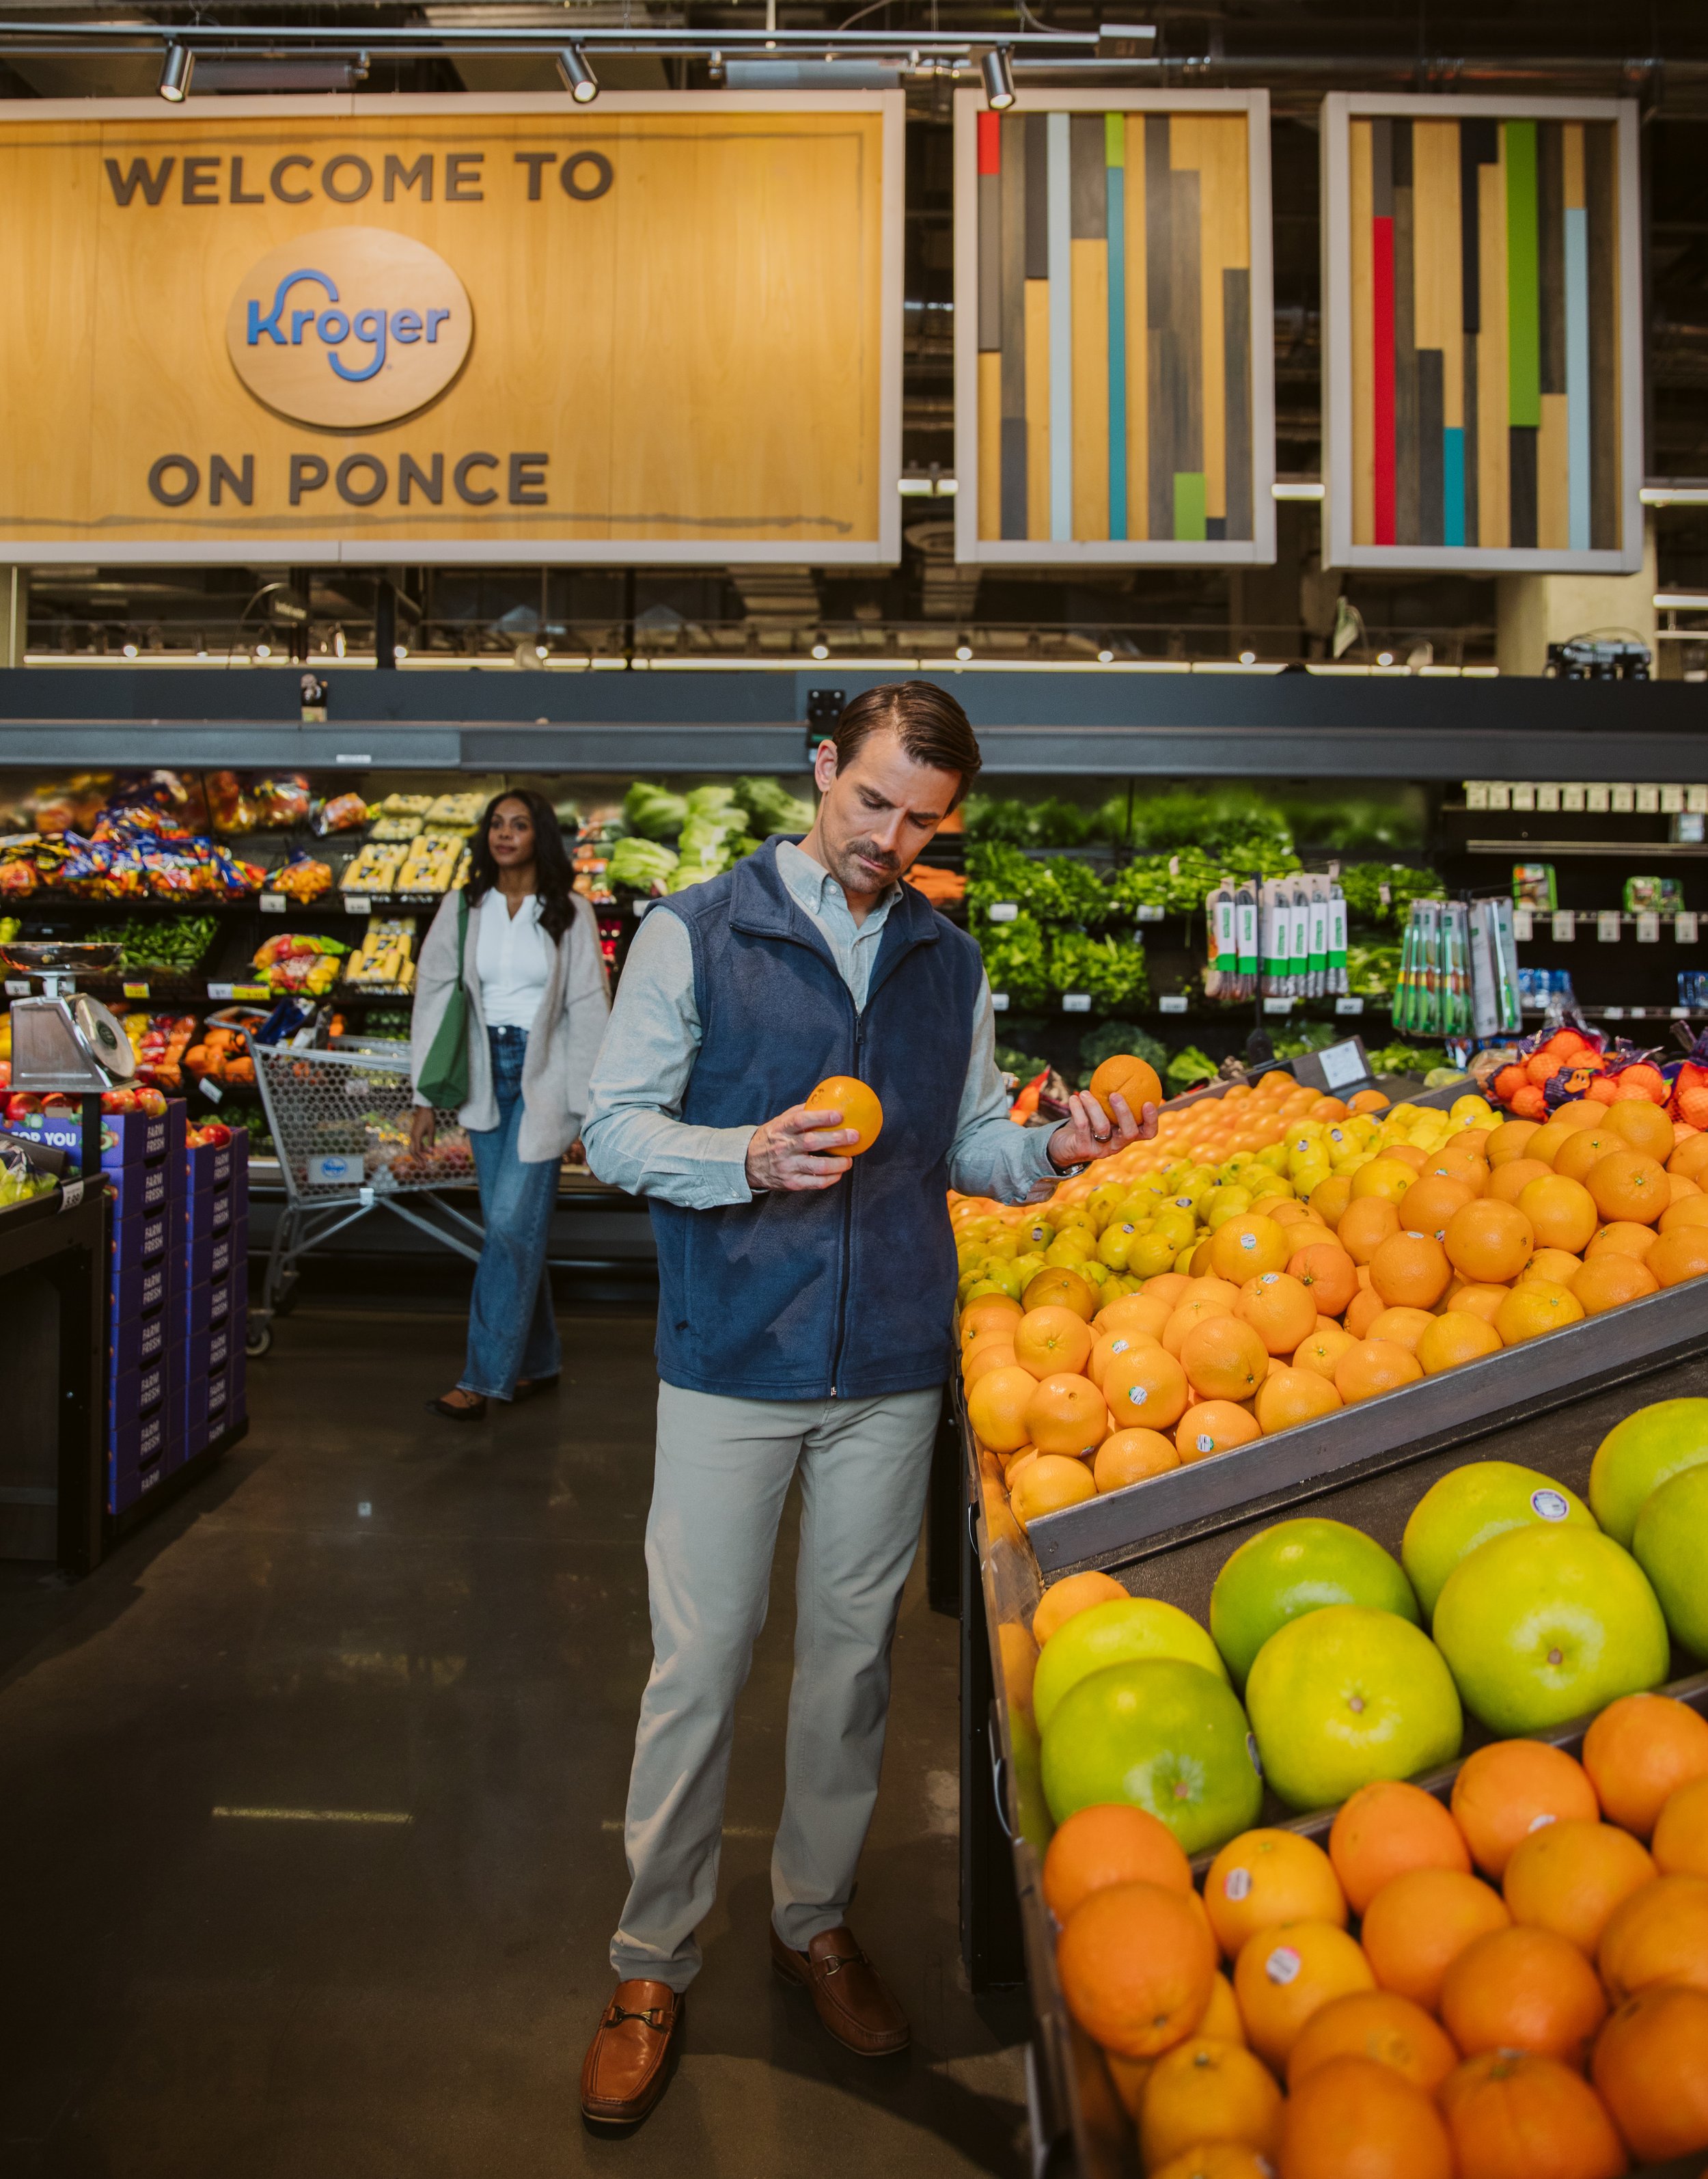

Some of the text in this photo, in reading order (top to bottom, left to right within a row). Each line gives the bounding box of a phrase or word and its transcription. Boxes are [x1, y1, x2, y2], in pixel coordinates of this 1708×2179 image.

[105, 151, 614, 206] WELCOME TO
[247, 269, 450, 383] Kroger
[148, 452, 549, 508] ON PONCE
[44, 1132, 77, 1147] YOU
[147, 1123, 165, 1139] FARM
[146, 1136, 165, 1153] FRESH
[146, 1171, 163, 1189] FARM
[144, 1185, 164, 1204] FRESH
[144, 1221, 163, 1240] FARM
[143, 1235, 164, 1255] FRESH
[143, 1272, 162, 1290] FARM
[142, 1285, 163, 1305] FRESH
[142, 1321, 161, 1341] FARM
[141, 1334, 162, 1356] FRESH
